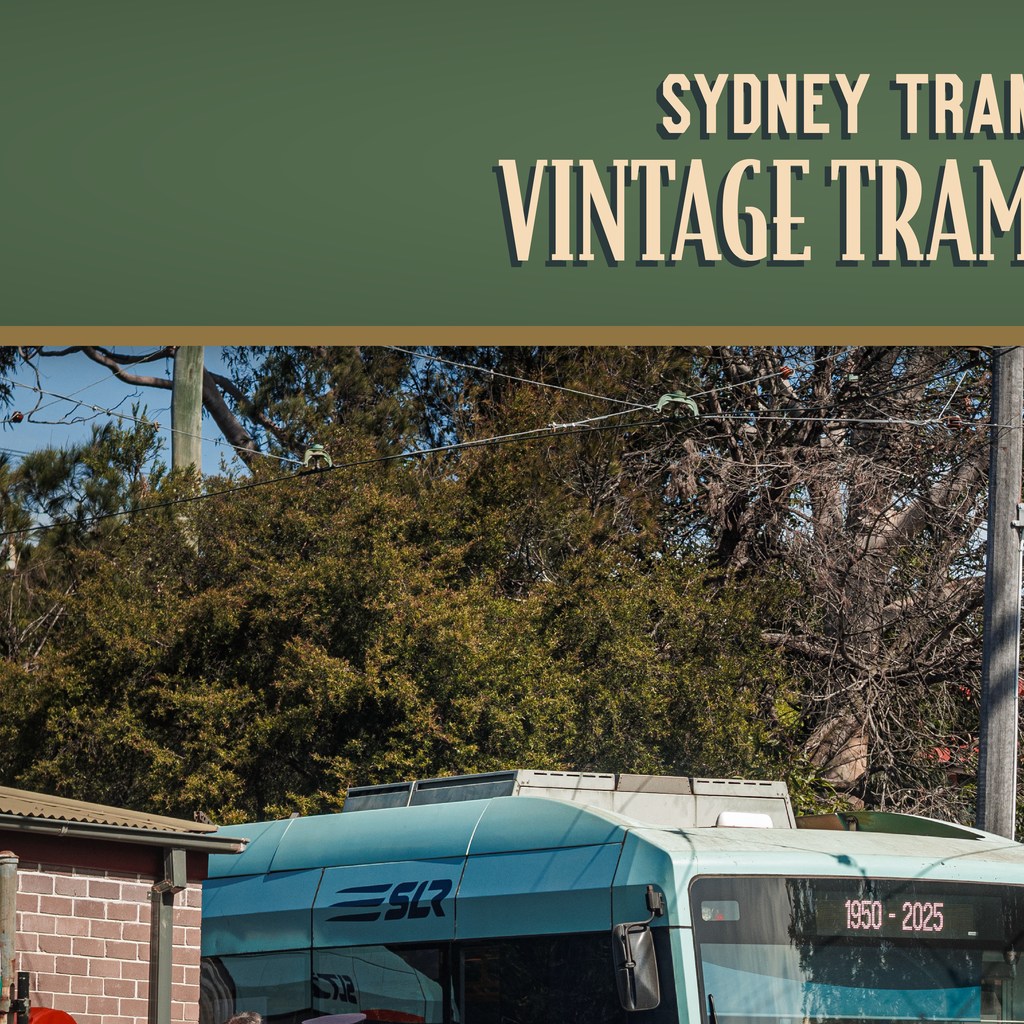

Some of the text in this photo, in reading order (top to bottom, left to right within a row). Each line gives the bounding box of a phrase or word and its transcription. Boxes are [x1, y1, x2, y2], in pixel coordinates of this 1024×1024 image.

[384, 879, 453, 921] SLR
[845, 900, 882, 930] 1950
[902, 902, 944, 931] 2025
